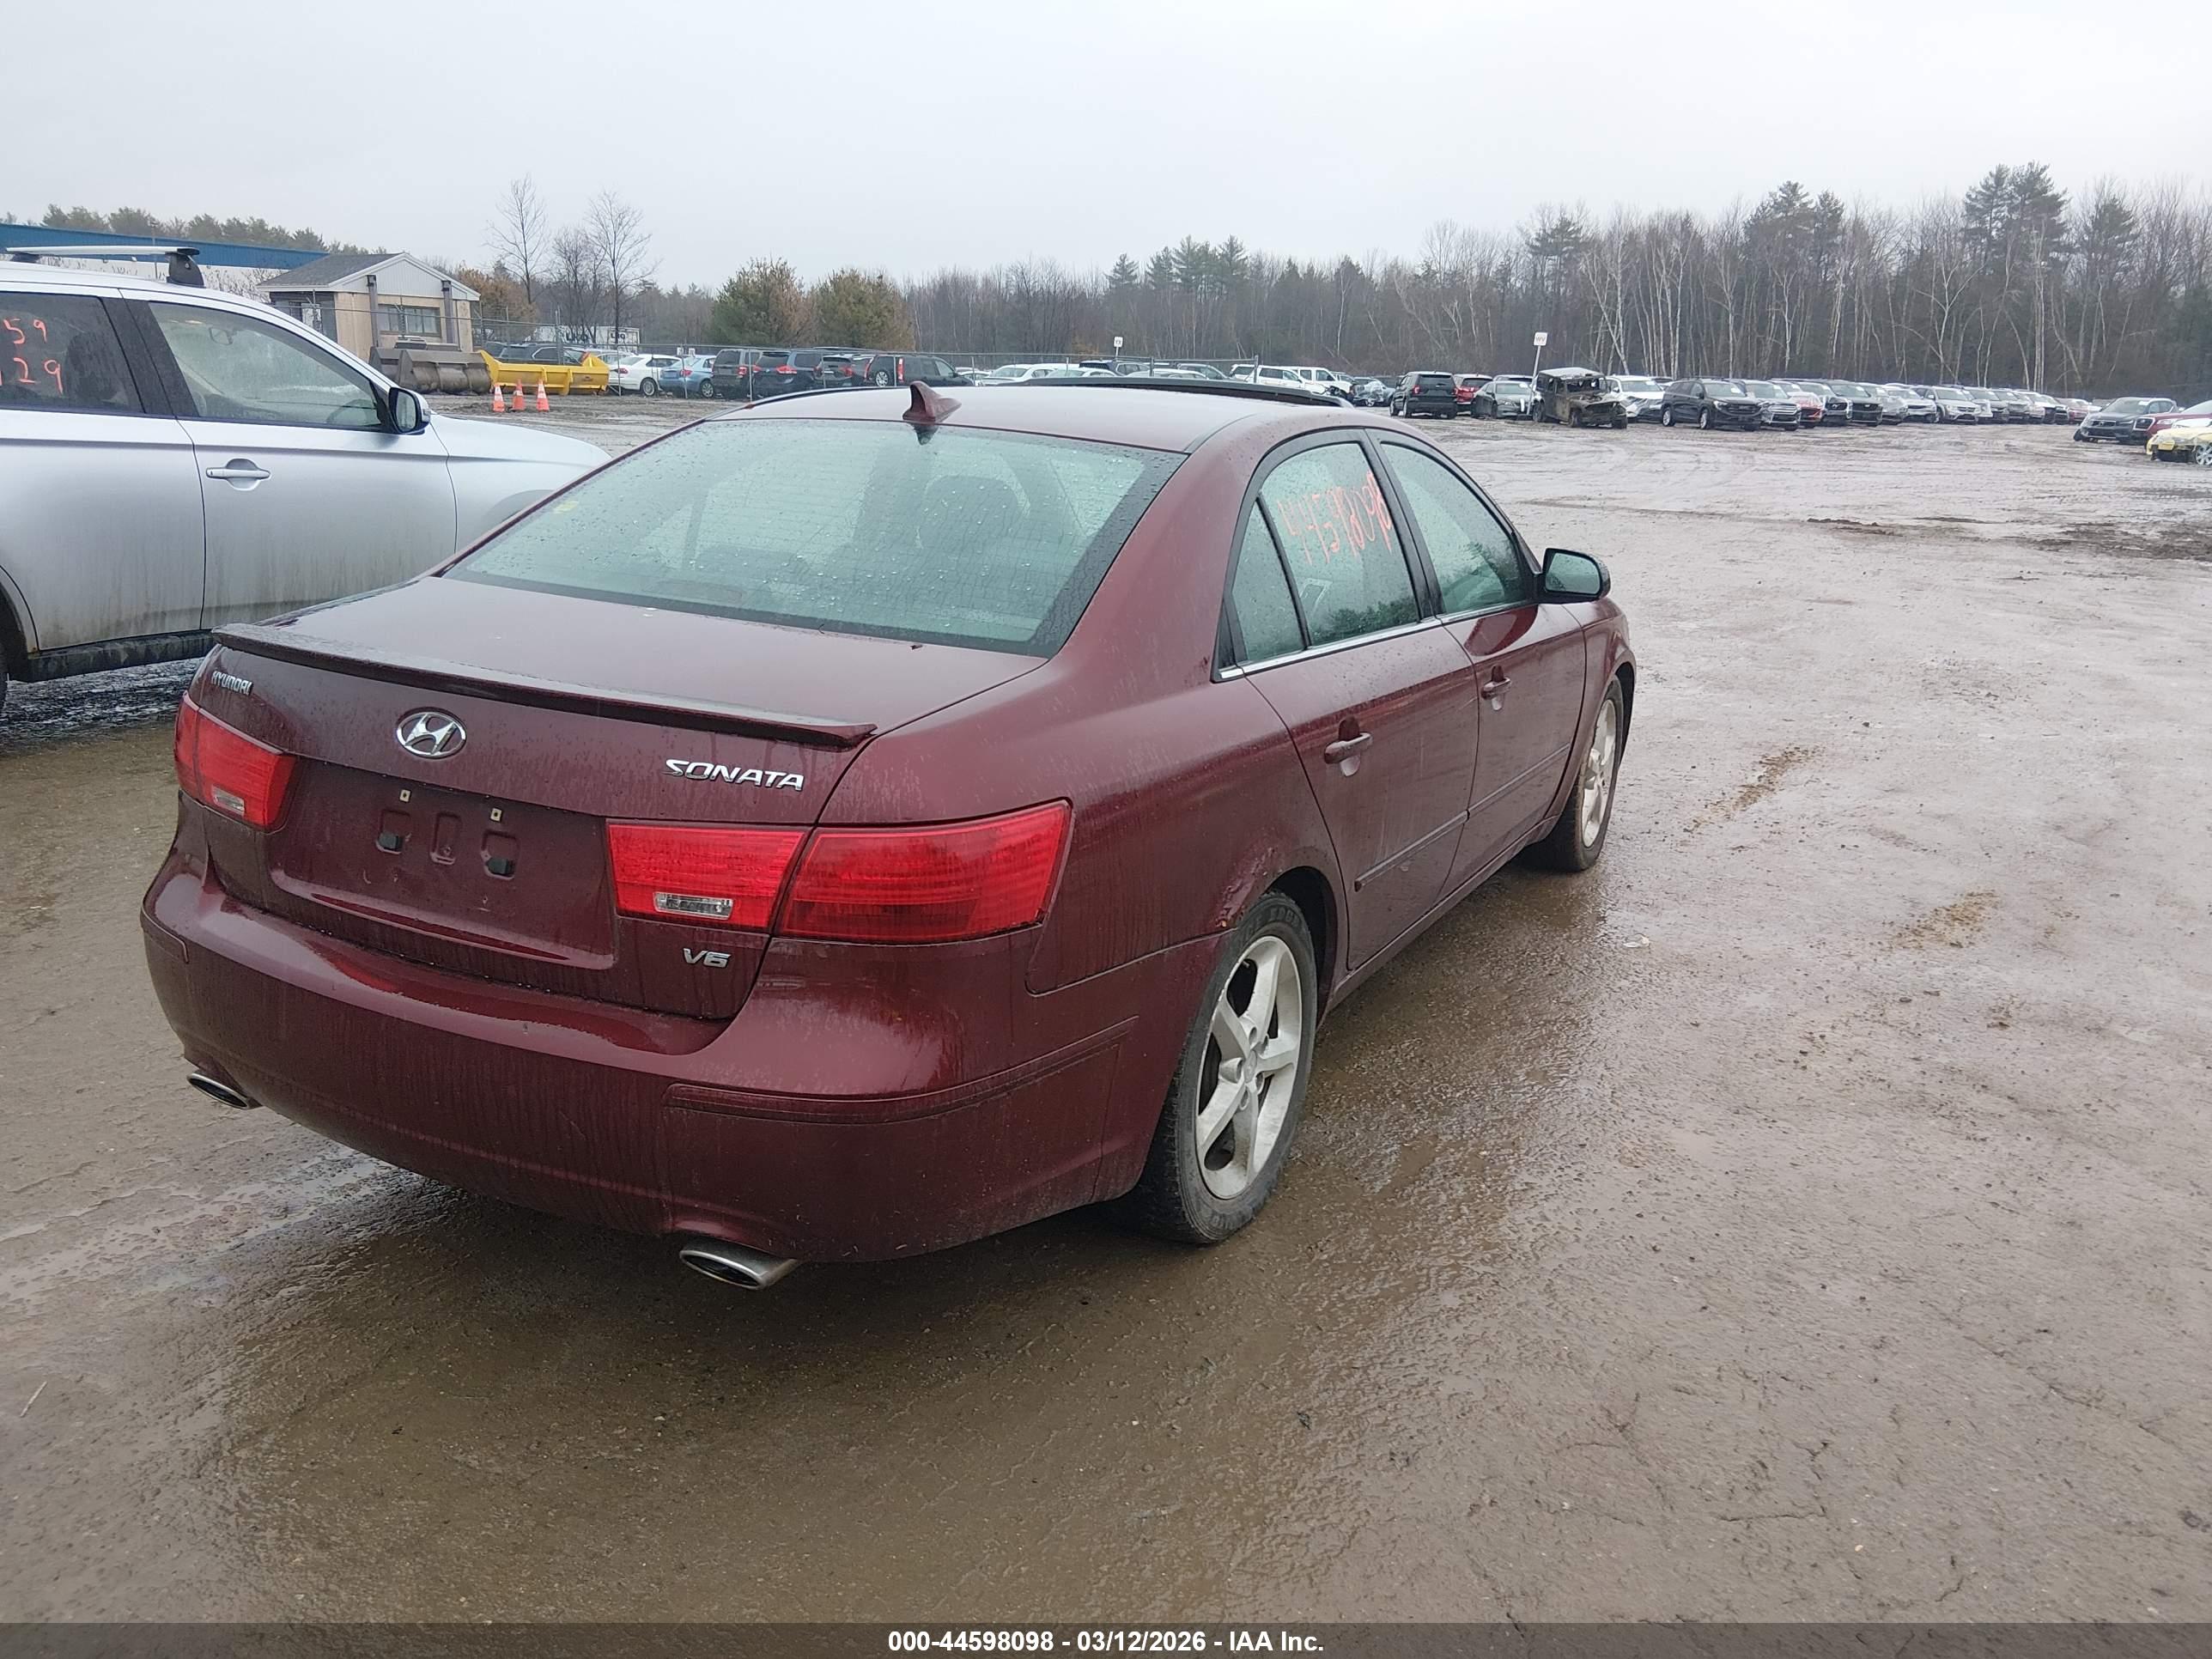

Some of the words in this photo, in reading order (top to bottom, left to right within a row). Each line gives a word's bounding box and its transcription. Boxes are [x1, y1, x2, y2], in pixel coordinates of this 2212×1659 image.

[210, 670, 253, 696] HYUNDAI
[664, 759, 805, 792] SONATA
[683, 947, 732, 969] V6
